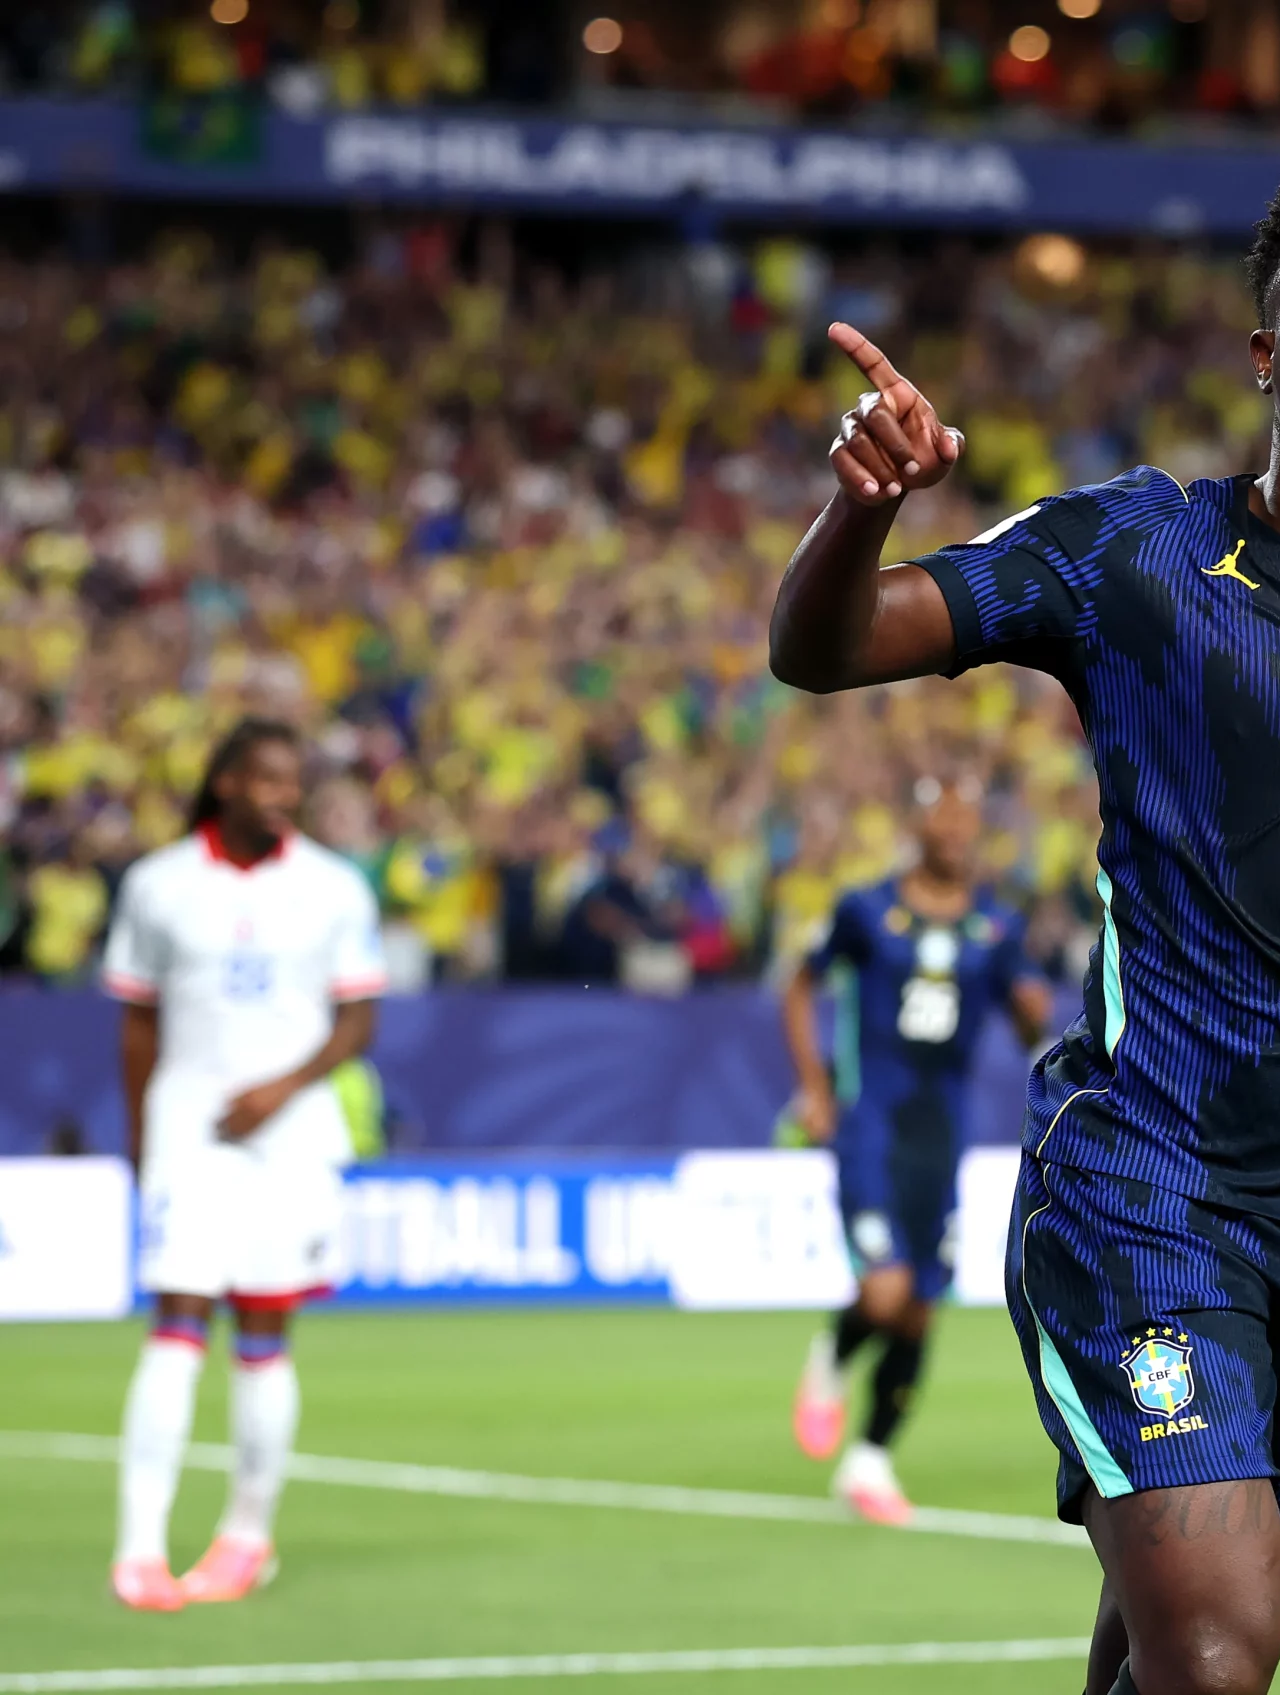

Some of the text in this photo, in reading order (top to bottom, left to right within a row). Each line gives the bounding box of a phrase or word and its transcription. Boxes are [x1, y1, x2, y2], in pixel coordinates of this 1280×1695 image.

[325, 119, 1027, 208] PHILADELPHIA
[1147, 1369, 1173, 1383] CBF
[1139, 1414, 1209, 1442] BRASIL
